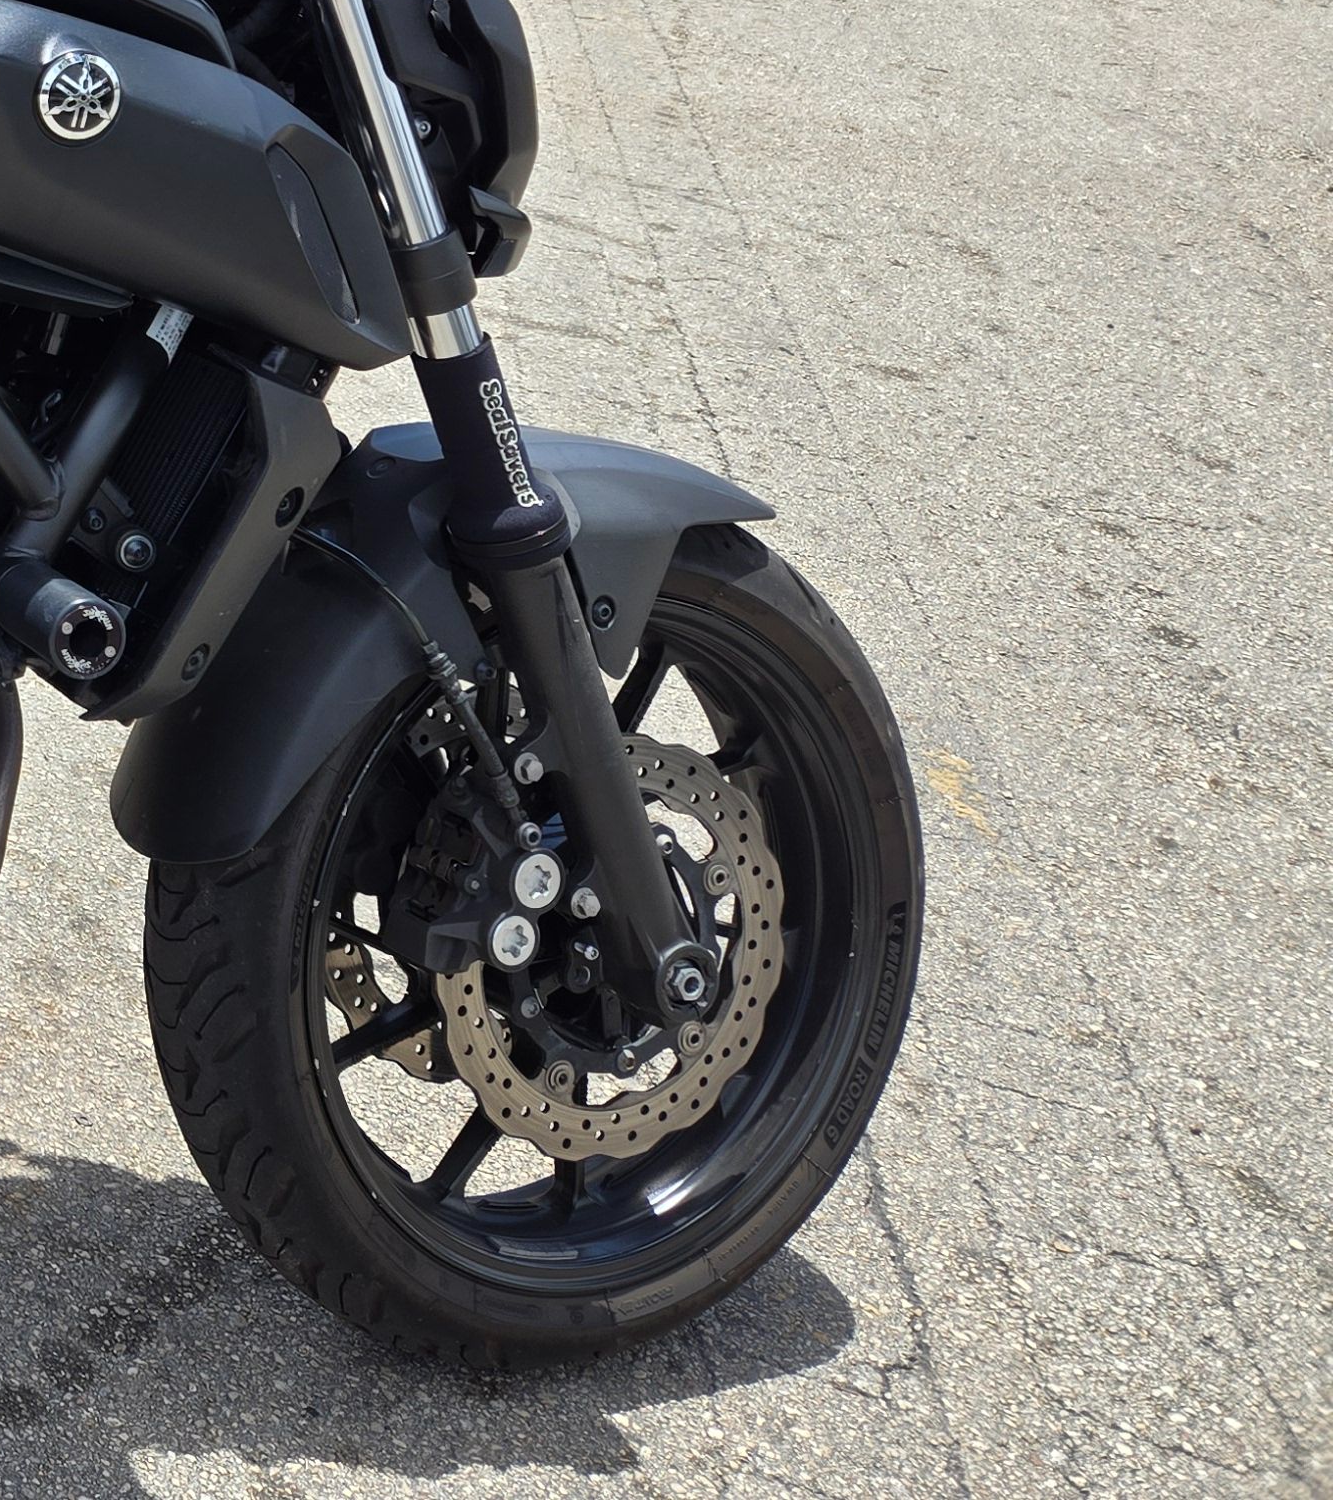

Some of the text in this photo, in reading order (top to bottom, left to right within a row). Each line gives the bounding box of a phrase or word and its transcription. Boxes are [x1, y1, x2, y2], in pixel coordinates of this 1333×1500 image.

[479, 378, 540, 508] SealSavers
[866, 939, 901, 1052] MICHELIN
[835, 1066, 868, 1129] ROAD
